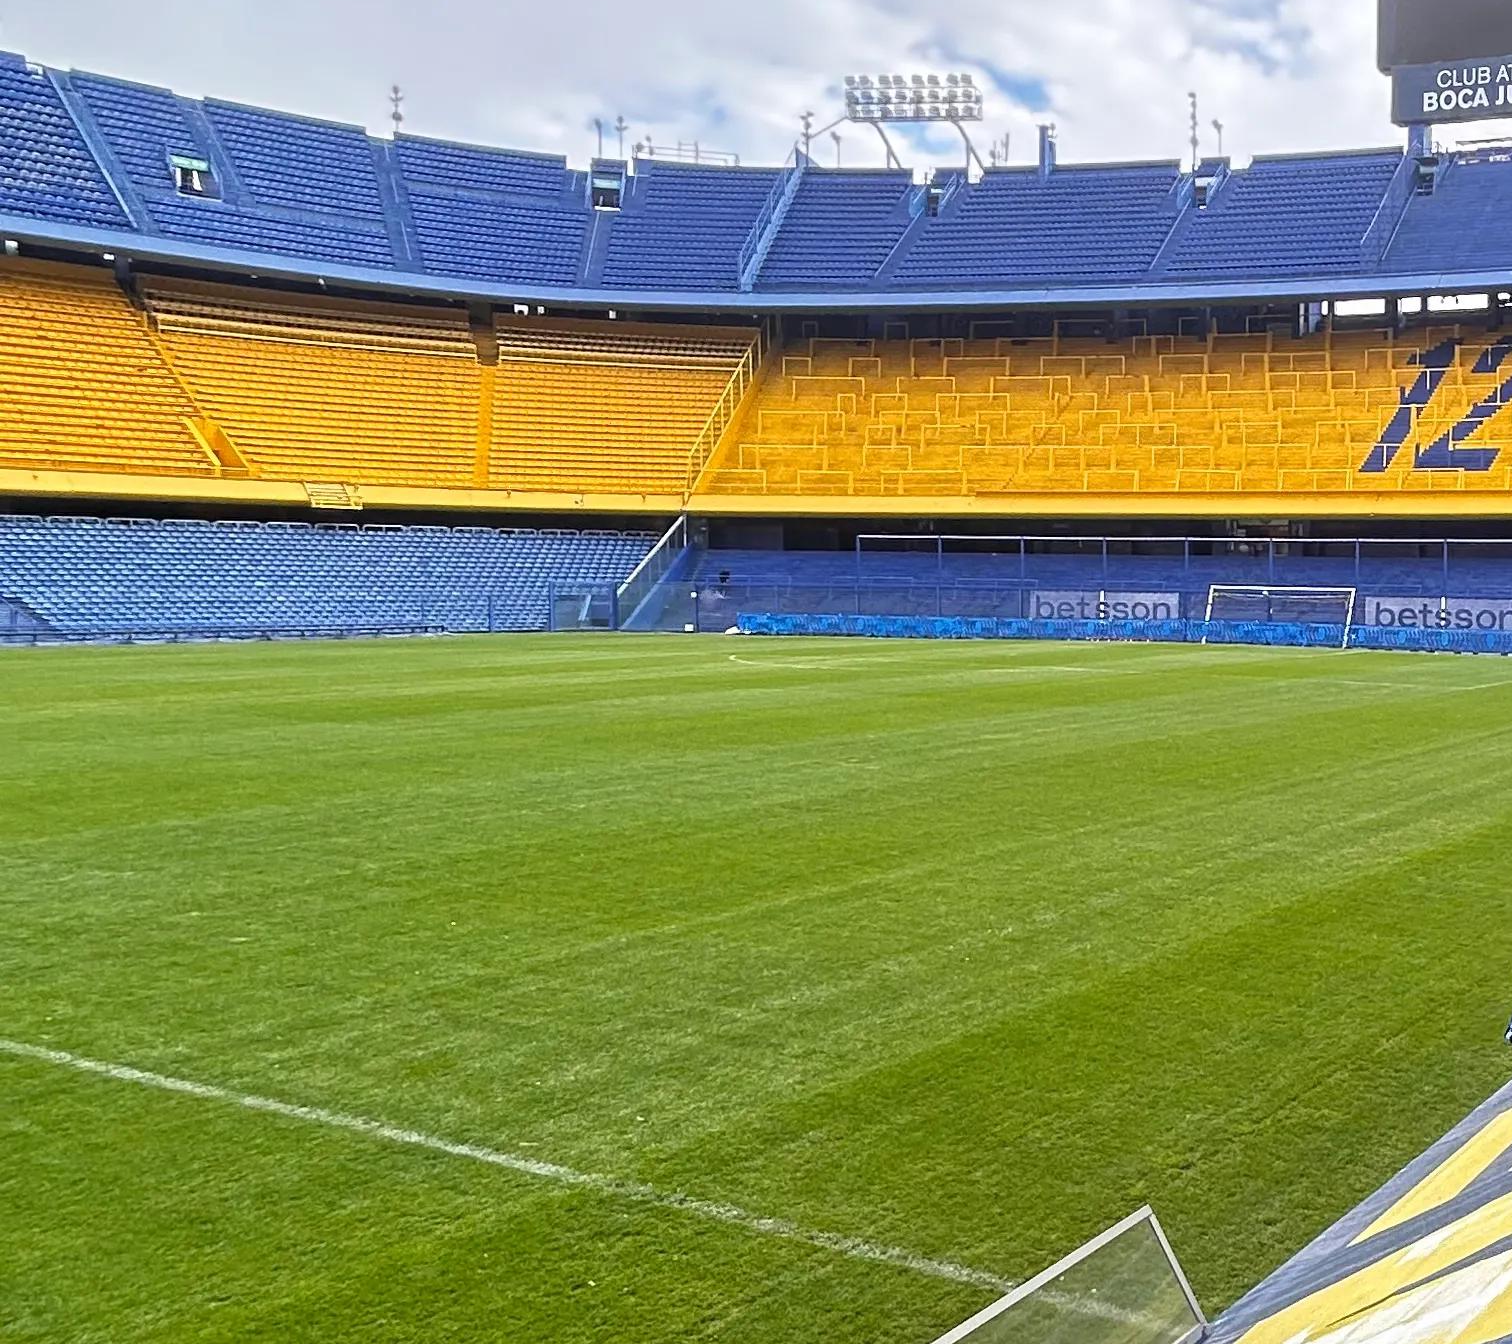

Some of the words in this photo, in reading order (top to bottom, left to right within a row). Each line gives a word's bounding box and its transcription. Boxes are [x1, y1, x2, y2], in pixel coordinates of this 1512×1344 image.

[1436, 66, 1491, 88] CLUB
[1423, 87, 1489, 112] BOCA
[1035, 594, 1170, 620] betsson
